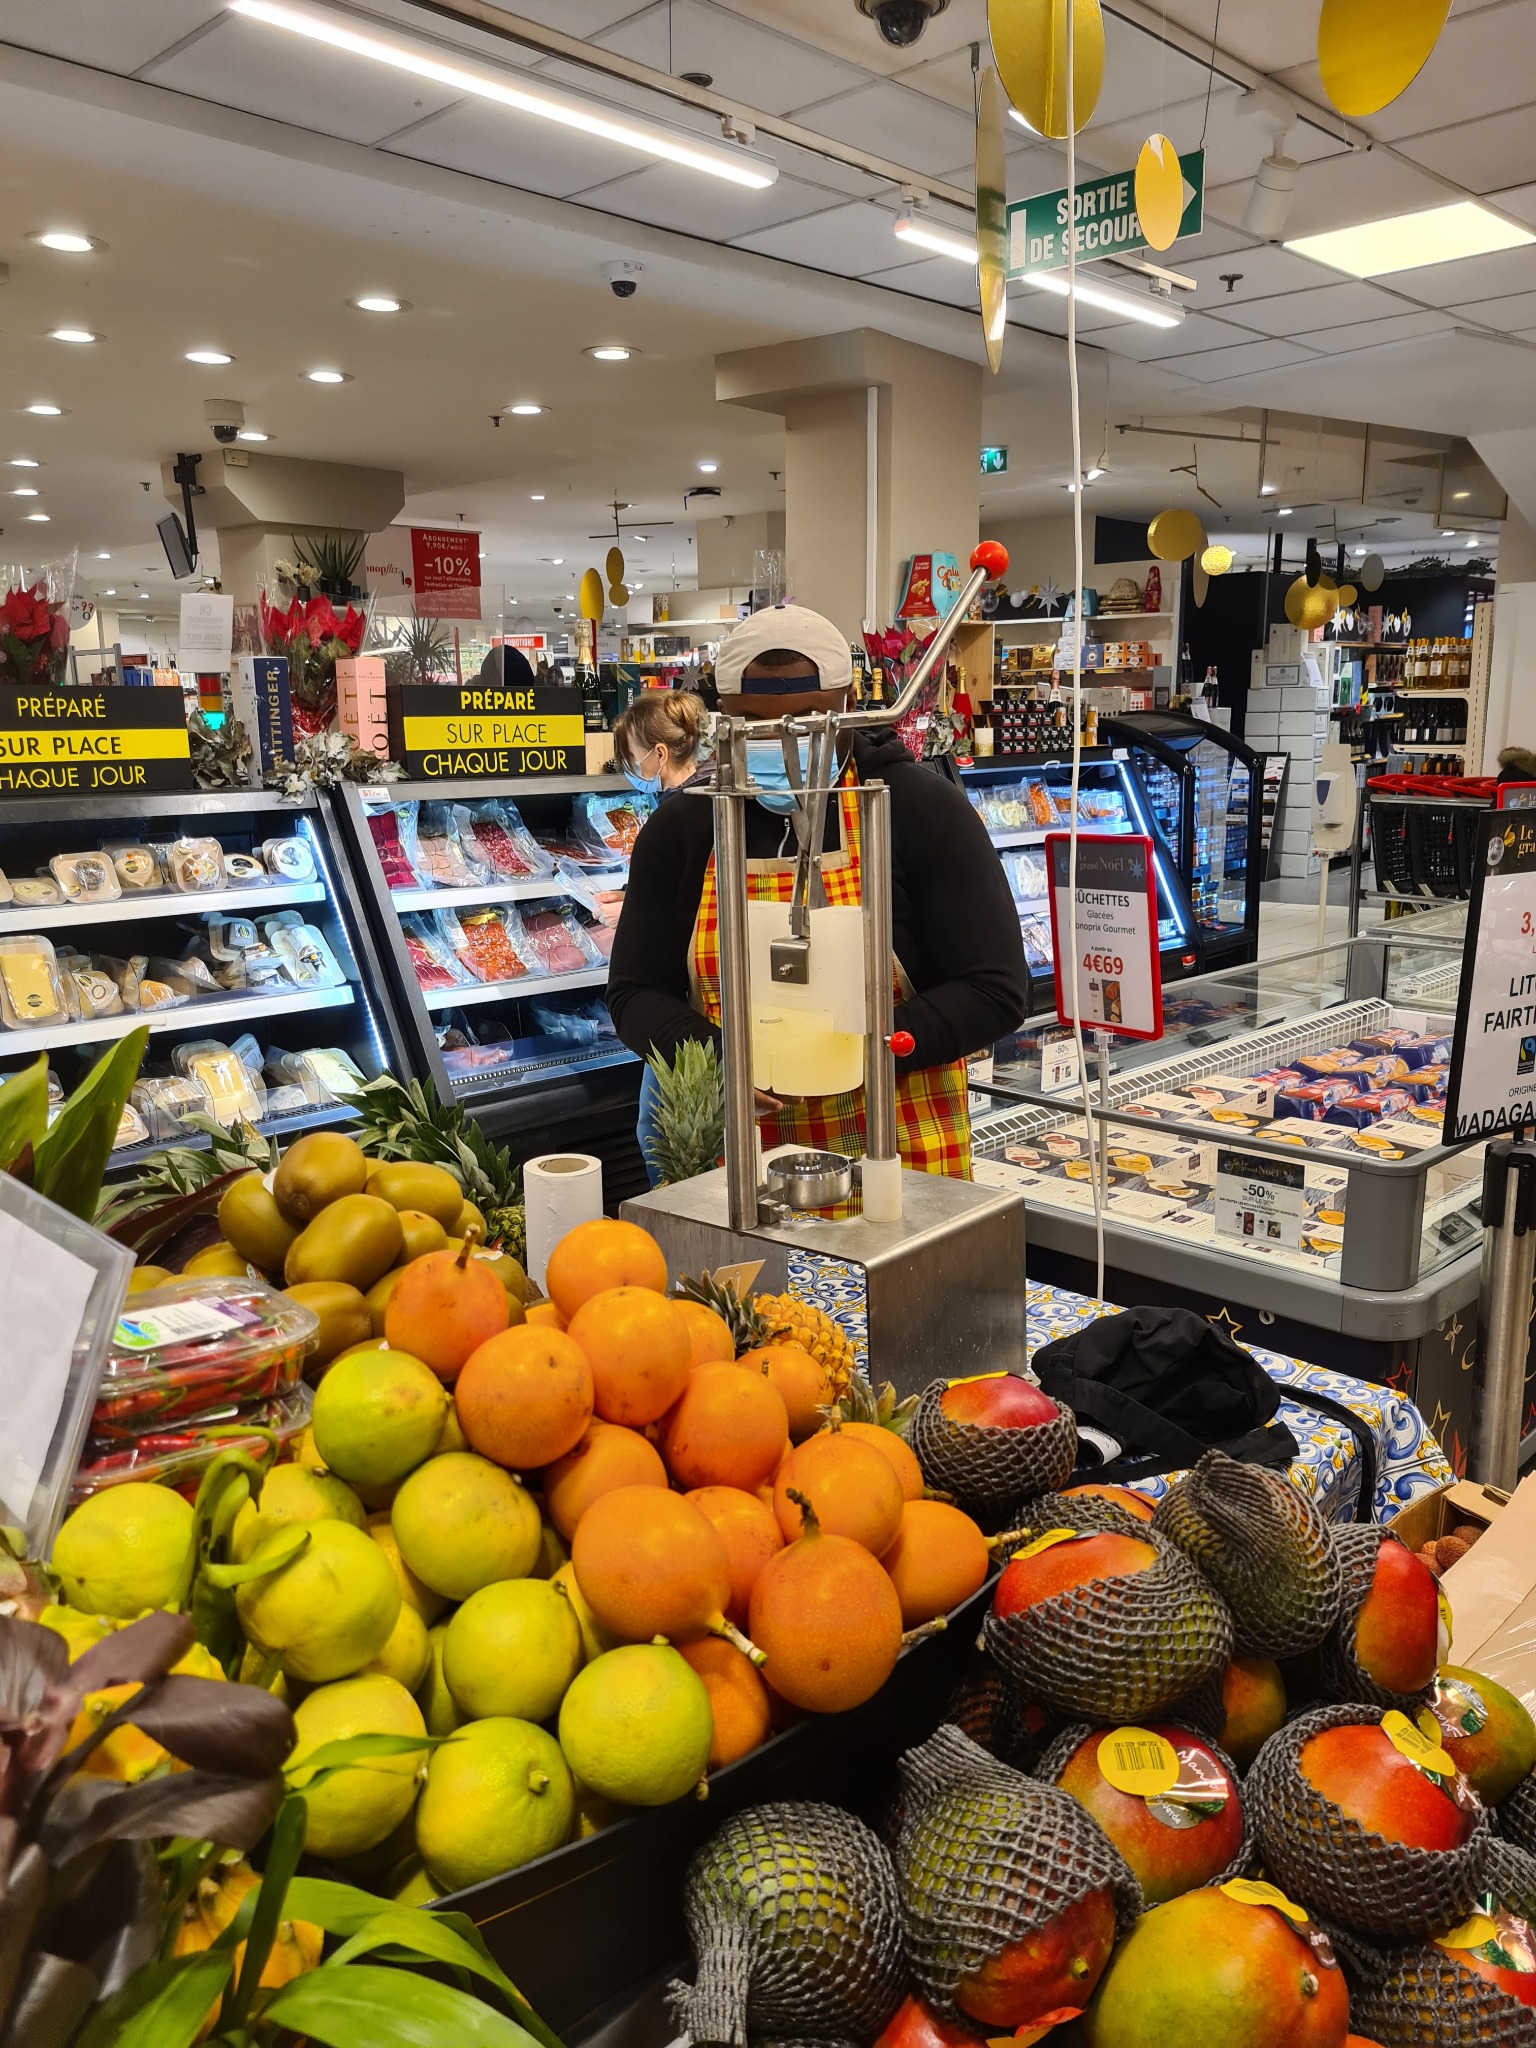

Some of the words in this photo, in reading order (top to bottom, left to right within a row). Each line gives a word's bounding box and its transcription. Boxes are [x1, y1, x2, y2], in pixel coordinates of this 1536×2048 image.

[1056, 181, 1129, 226] SORTIE
[1030, 233, 1054, 264] DE
[1060, 212, 1144, 256] SECOUR
[424, 556, 472, 576] -10%
[17, 692, 107, 718] PRÉPARÉ
[460, 688, 536, 711] PRÉPARÉ
[265, 669, 283, 766] AITTINGER
[367, 688, 389, 752] OËT
[447, 723, 484, 744] SUR
[493, 723, 548, 743] PLACE
[0, 737, 42, 757] SUR
[53, 737, 122, 755] PLACE
[423, 752, 510, 776] CHAQUE
[519, 749, 568, 773] JOUR
[0, 767, 80, 790] HAQUE
[91, 765, 147, 788] JOUR
[1519, 824, 1534, 841] Le
[1517, 842, 1536, 859] gra
[1099, 855, 1124, 872] Noël
[1075, 891, 1130, 907] ÛCHETTES
[1086, 909, 1114, 921] Glacées
[1521, 911, 1536, 937] 3,
[1069, 921, 1102, 933] onoprix
[1102, 923, 1136, 936] Gourmet
[1082, 953, 1124, 976] 4€69
[1509, 974, 1536, 998] LIT
[1455, 1101, 1536, 1138] MADAGA
[1259, 1165, 1279, 1178] Noël
[1162, 1803, 1182, 1825] Verde
